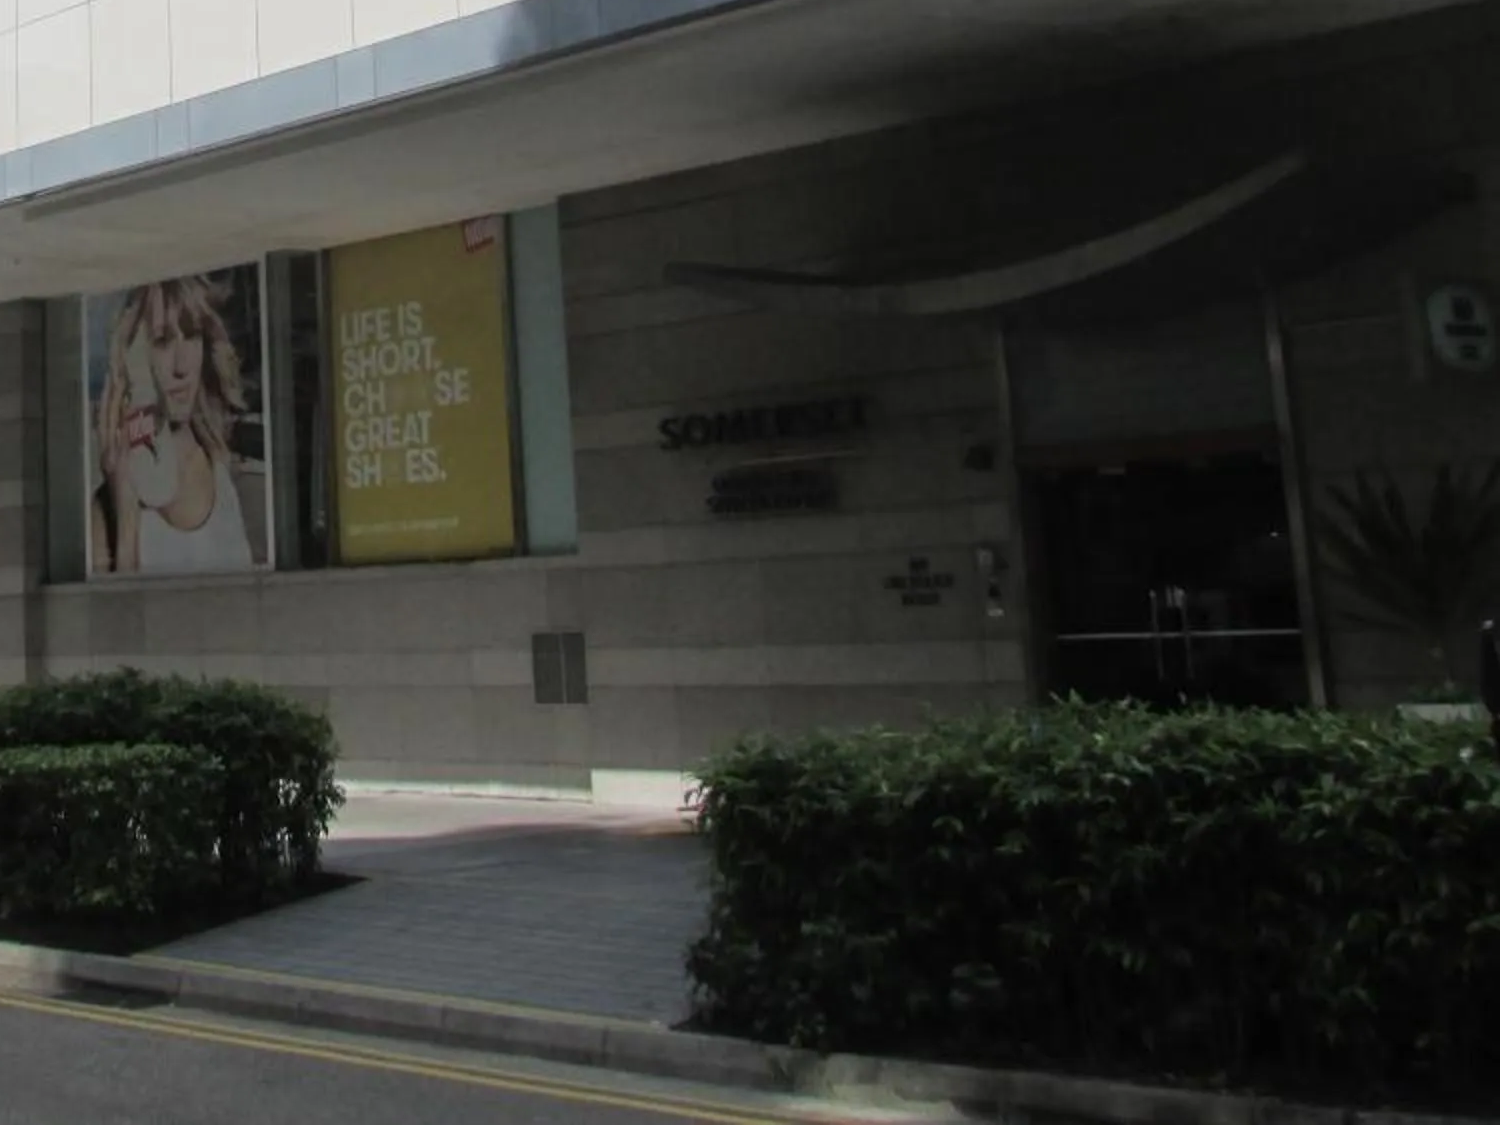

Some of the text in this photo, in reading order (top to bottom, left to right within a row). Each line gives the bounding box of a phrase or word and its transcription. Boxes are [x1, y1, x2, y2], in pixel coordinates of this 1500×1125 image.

[341, 301, 423, 347] LIFE IS
[342, 336, 443, 382] SHORT.
[345, 410, 433, 452] GREAT
